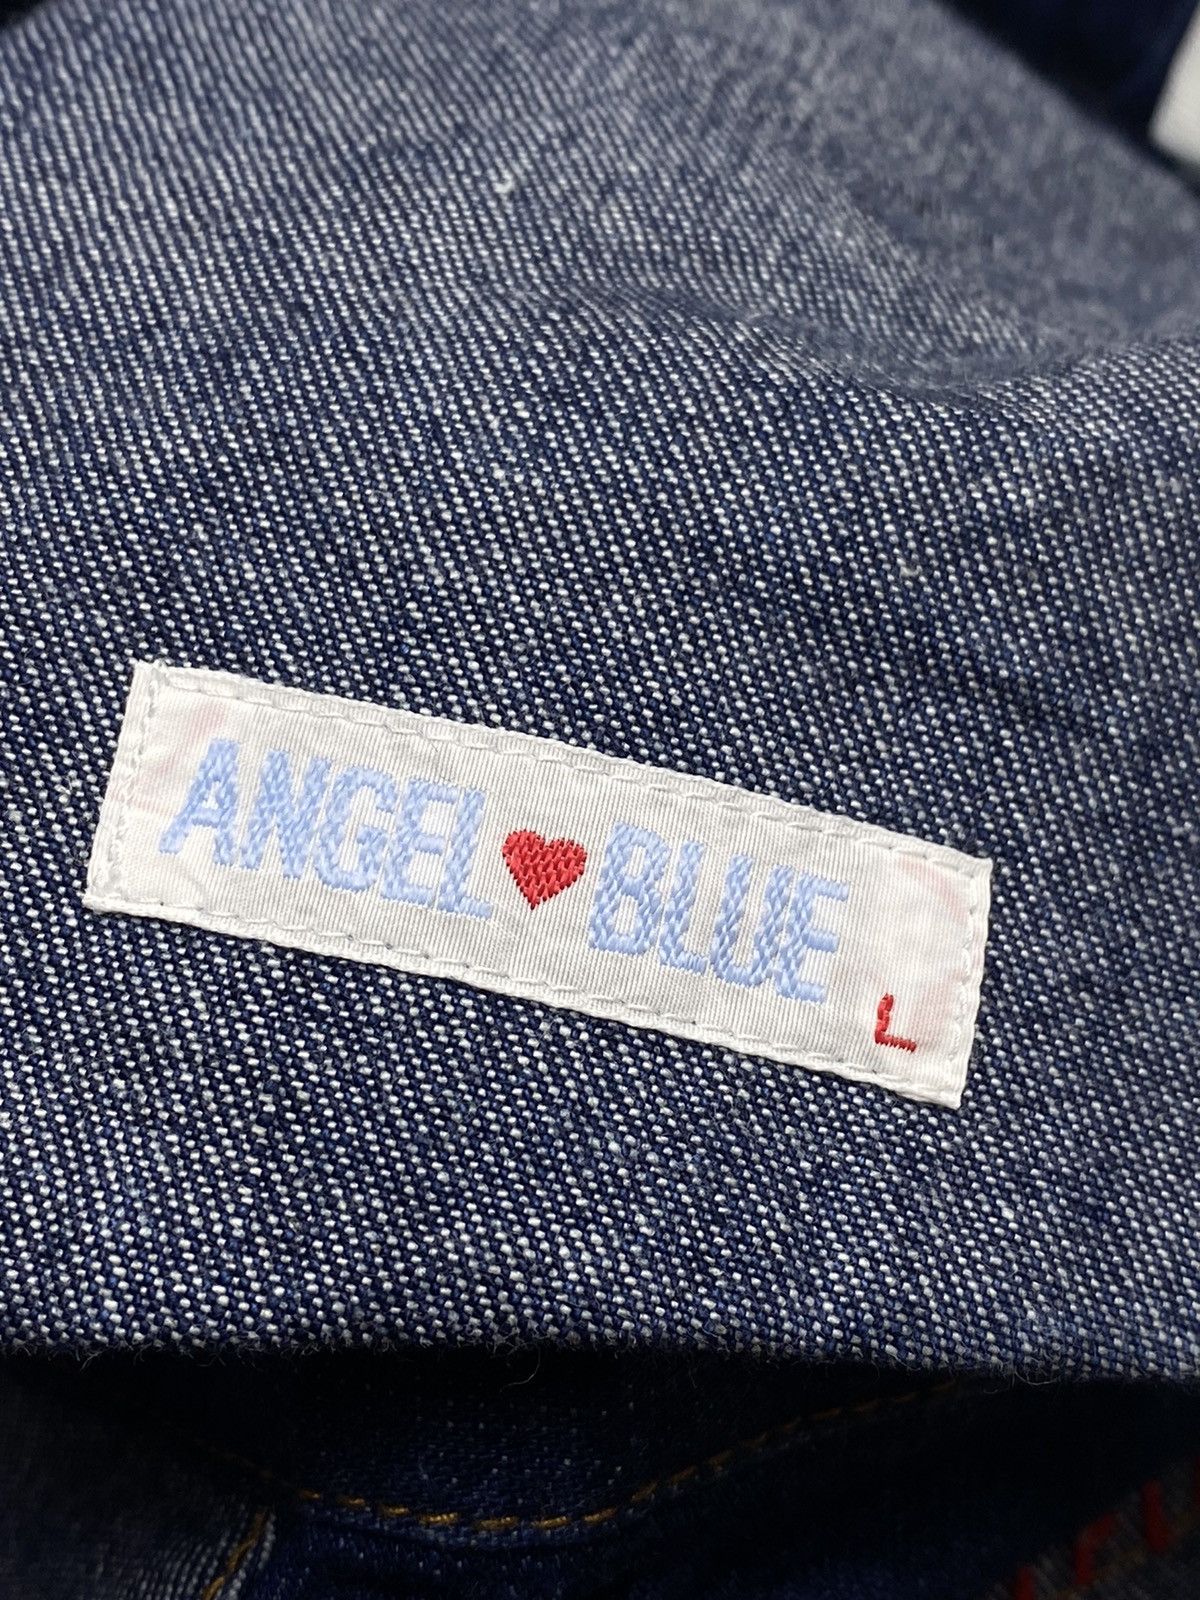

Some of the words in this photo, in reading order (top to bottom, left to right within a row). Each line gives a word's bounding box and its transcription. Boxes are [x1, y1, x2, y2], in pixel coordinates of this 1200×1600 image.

[157, 738, 492, 920] ANGEL
[587, 820, 849, 1002] BLUE
[875, 994, 917, 1052] L
